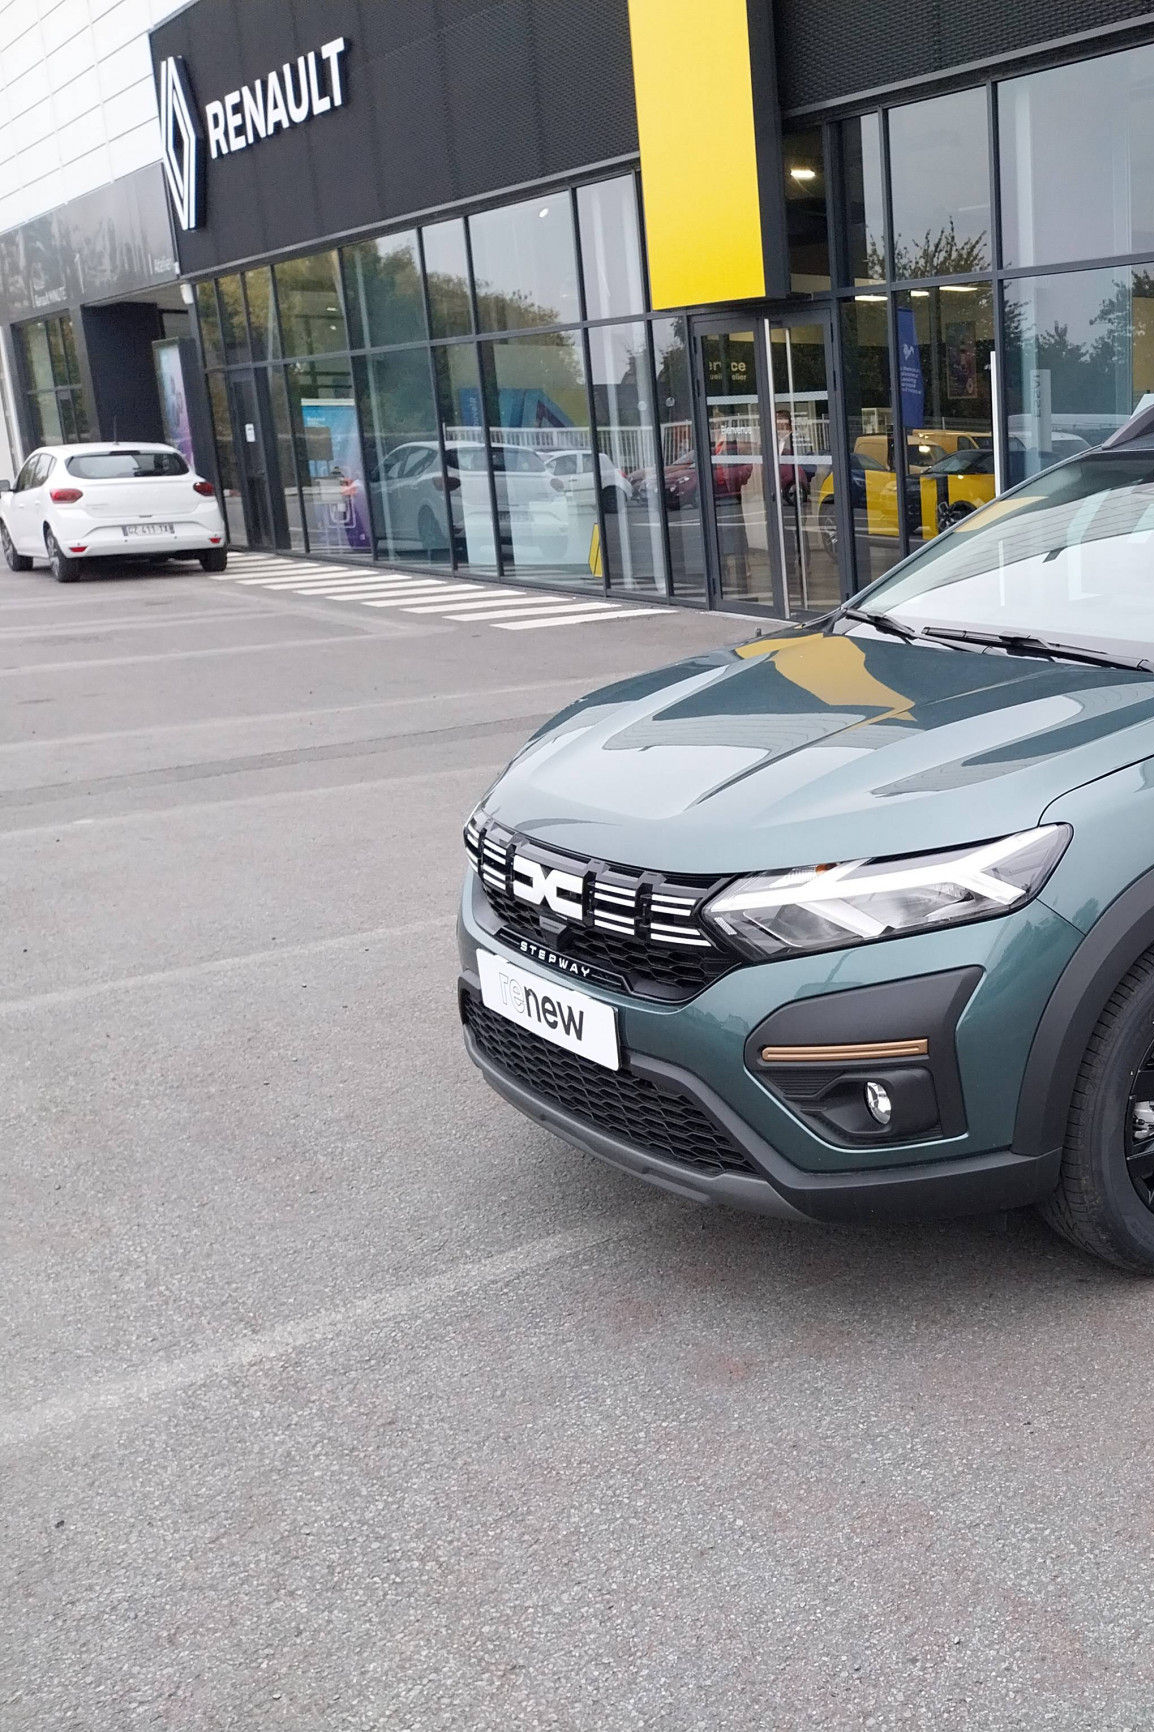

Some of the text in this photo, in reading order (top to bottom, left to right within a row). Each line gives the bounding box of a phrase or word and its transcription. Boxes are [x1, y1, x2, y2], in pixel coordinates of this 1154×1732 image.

[205, 36, 345, 160] RENAULT
[520, 940, 590, 977] STEPWAY
[499, 972, 584, 1042] renew
